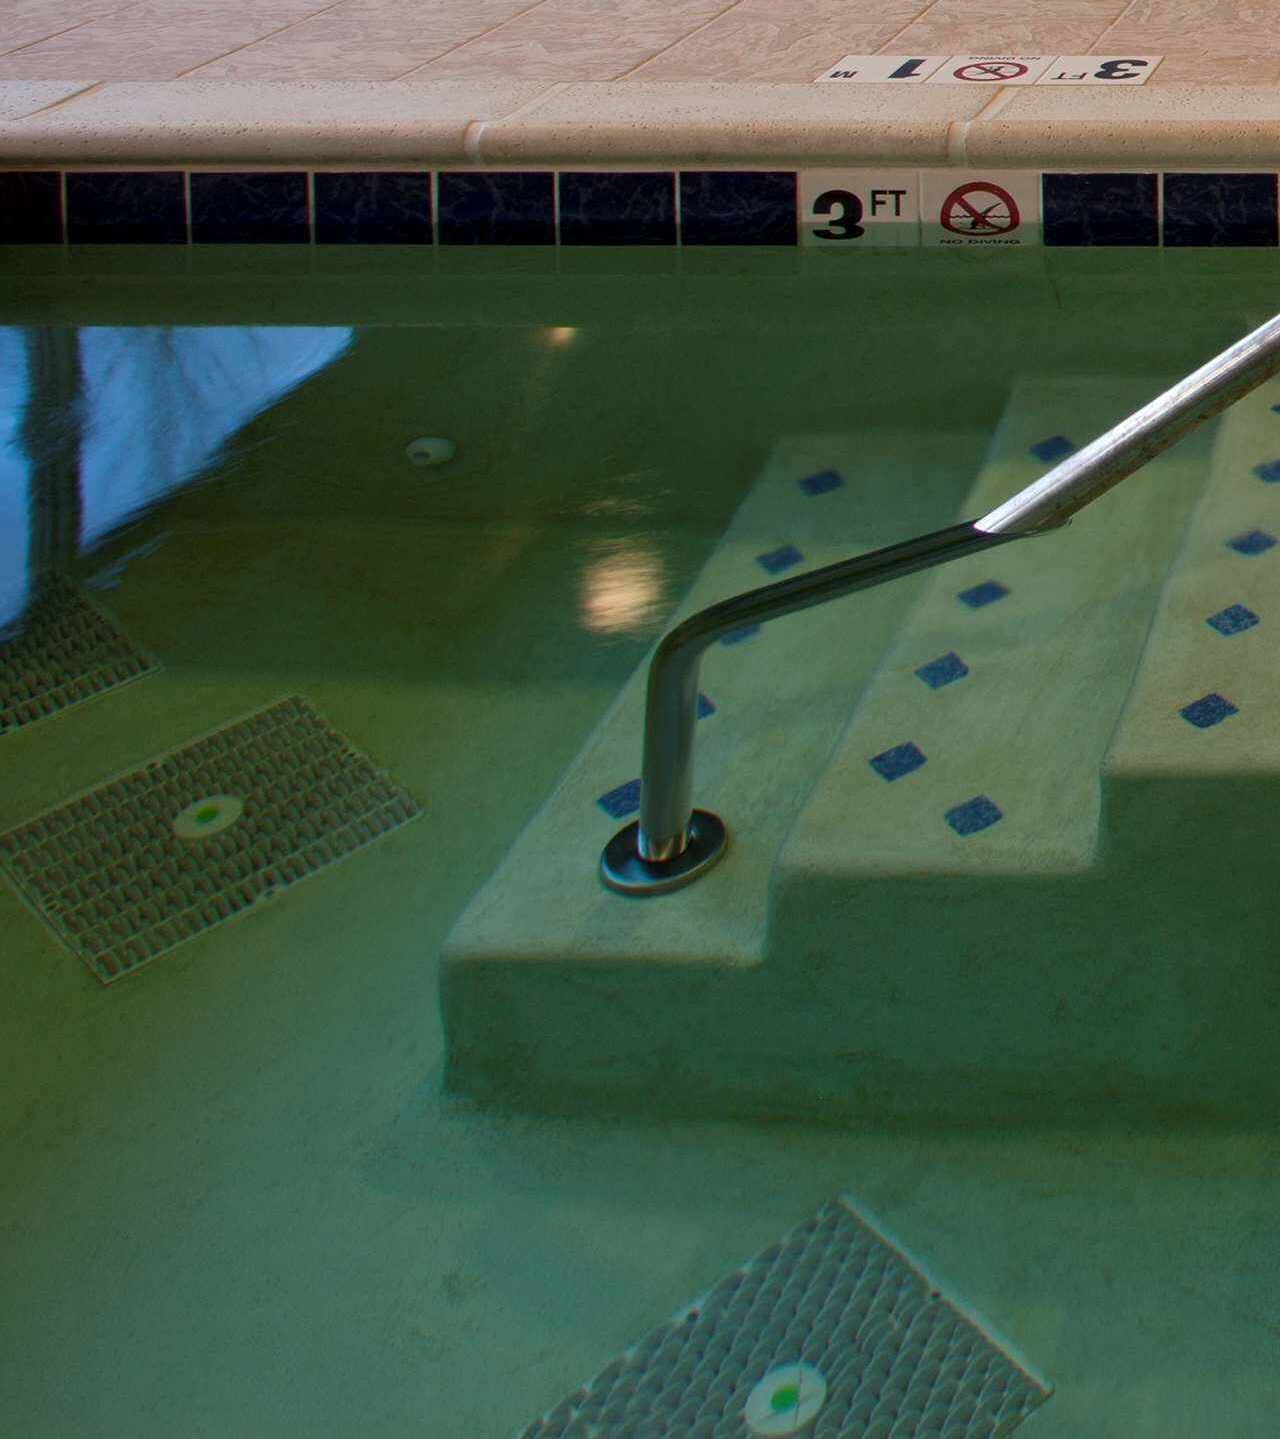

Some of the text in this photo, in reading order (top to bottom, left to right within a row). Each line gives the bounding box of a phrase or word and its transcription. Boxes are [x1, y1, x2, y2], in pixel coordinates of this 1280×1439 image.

[888, 59, 927, 79] 1
[1051, 59, 1149, 80] 3 FT
[812, 189, 906, 240] 3 FT
